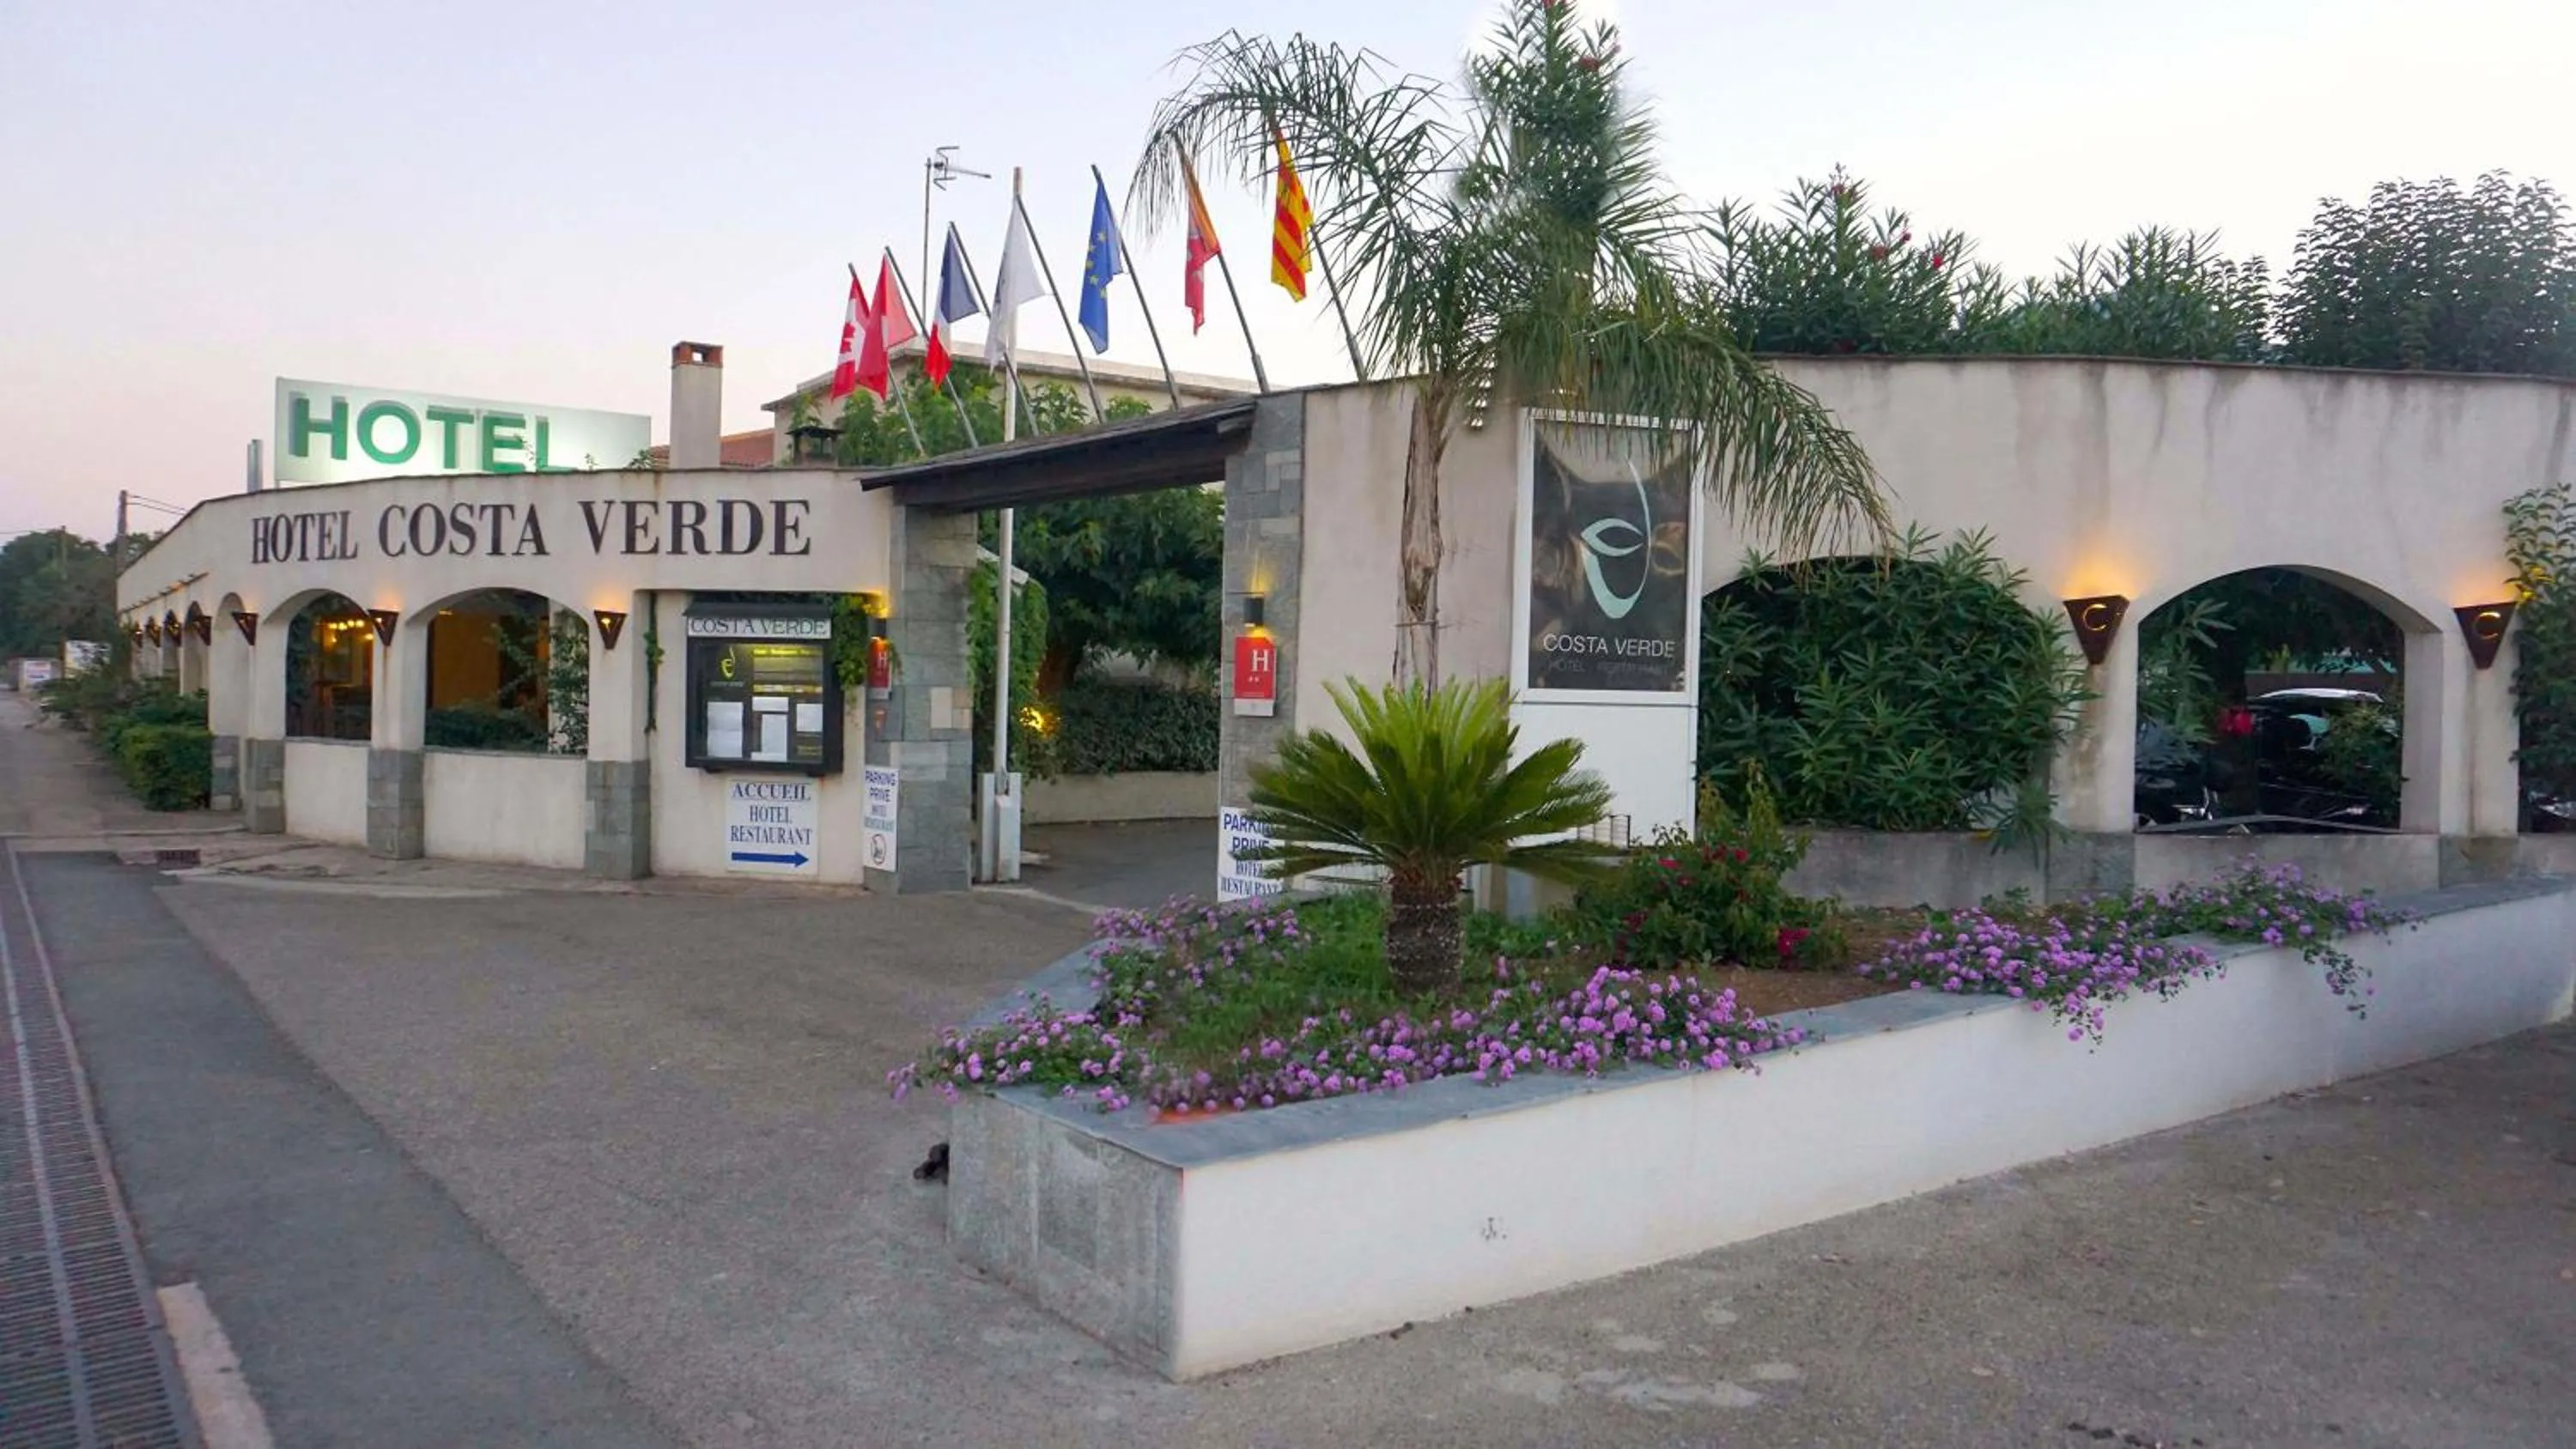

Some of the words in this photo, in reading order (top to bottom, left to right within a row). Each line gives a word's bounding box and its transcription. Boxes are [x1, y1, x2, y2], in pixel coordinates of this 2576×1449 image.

[289, 391, 577, 474] HOTEL
[252, 510, 358, 564] HOTEL
[378, 501, 550, 558] COSTA
[577, 498, 811, 556] VERDE
[690, 617, 756, 634] COSTA
[758, 617, 827, 635] VERDE
[1543, 633, 1608, 655] COSTA
[1614, 637, 1675, 659] VERDE
[1252, 648, 1268, 673] H
[732, 782, 811, 801] ACCUEIL
[749, 804, 793, 824] HOTEL
[729, 825, 813, 845] RESTAURANT
